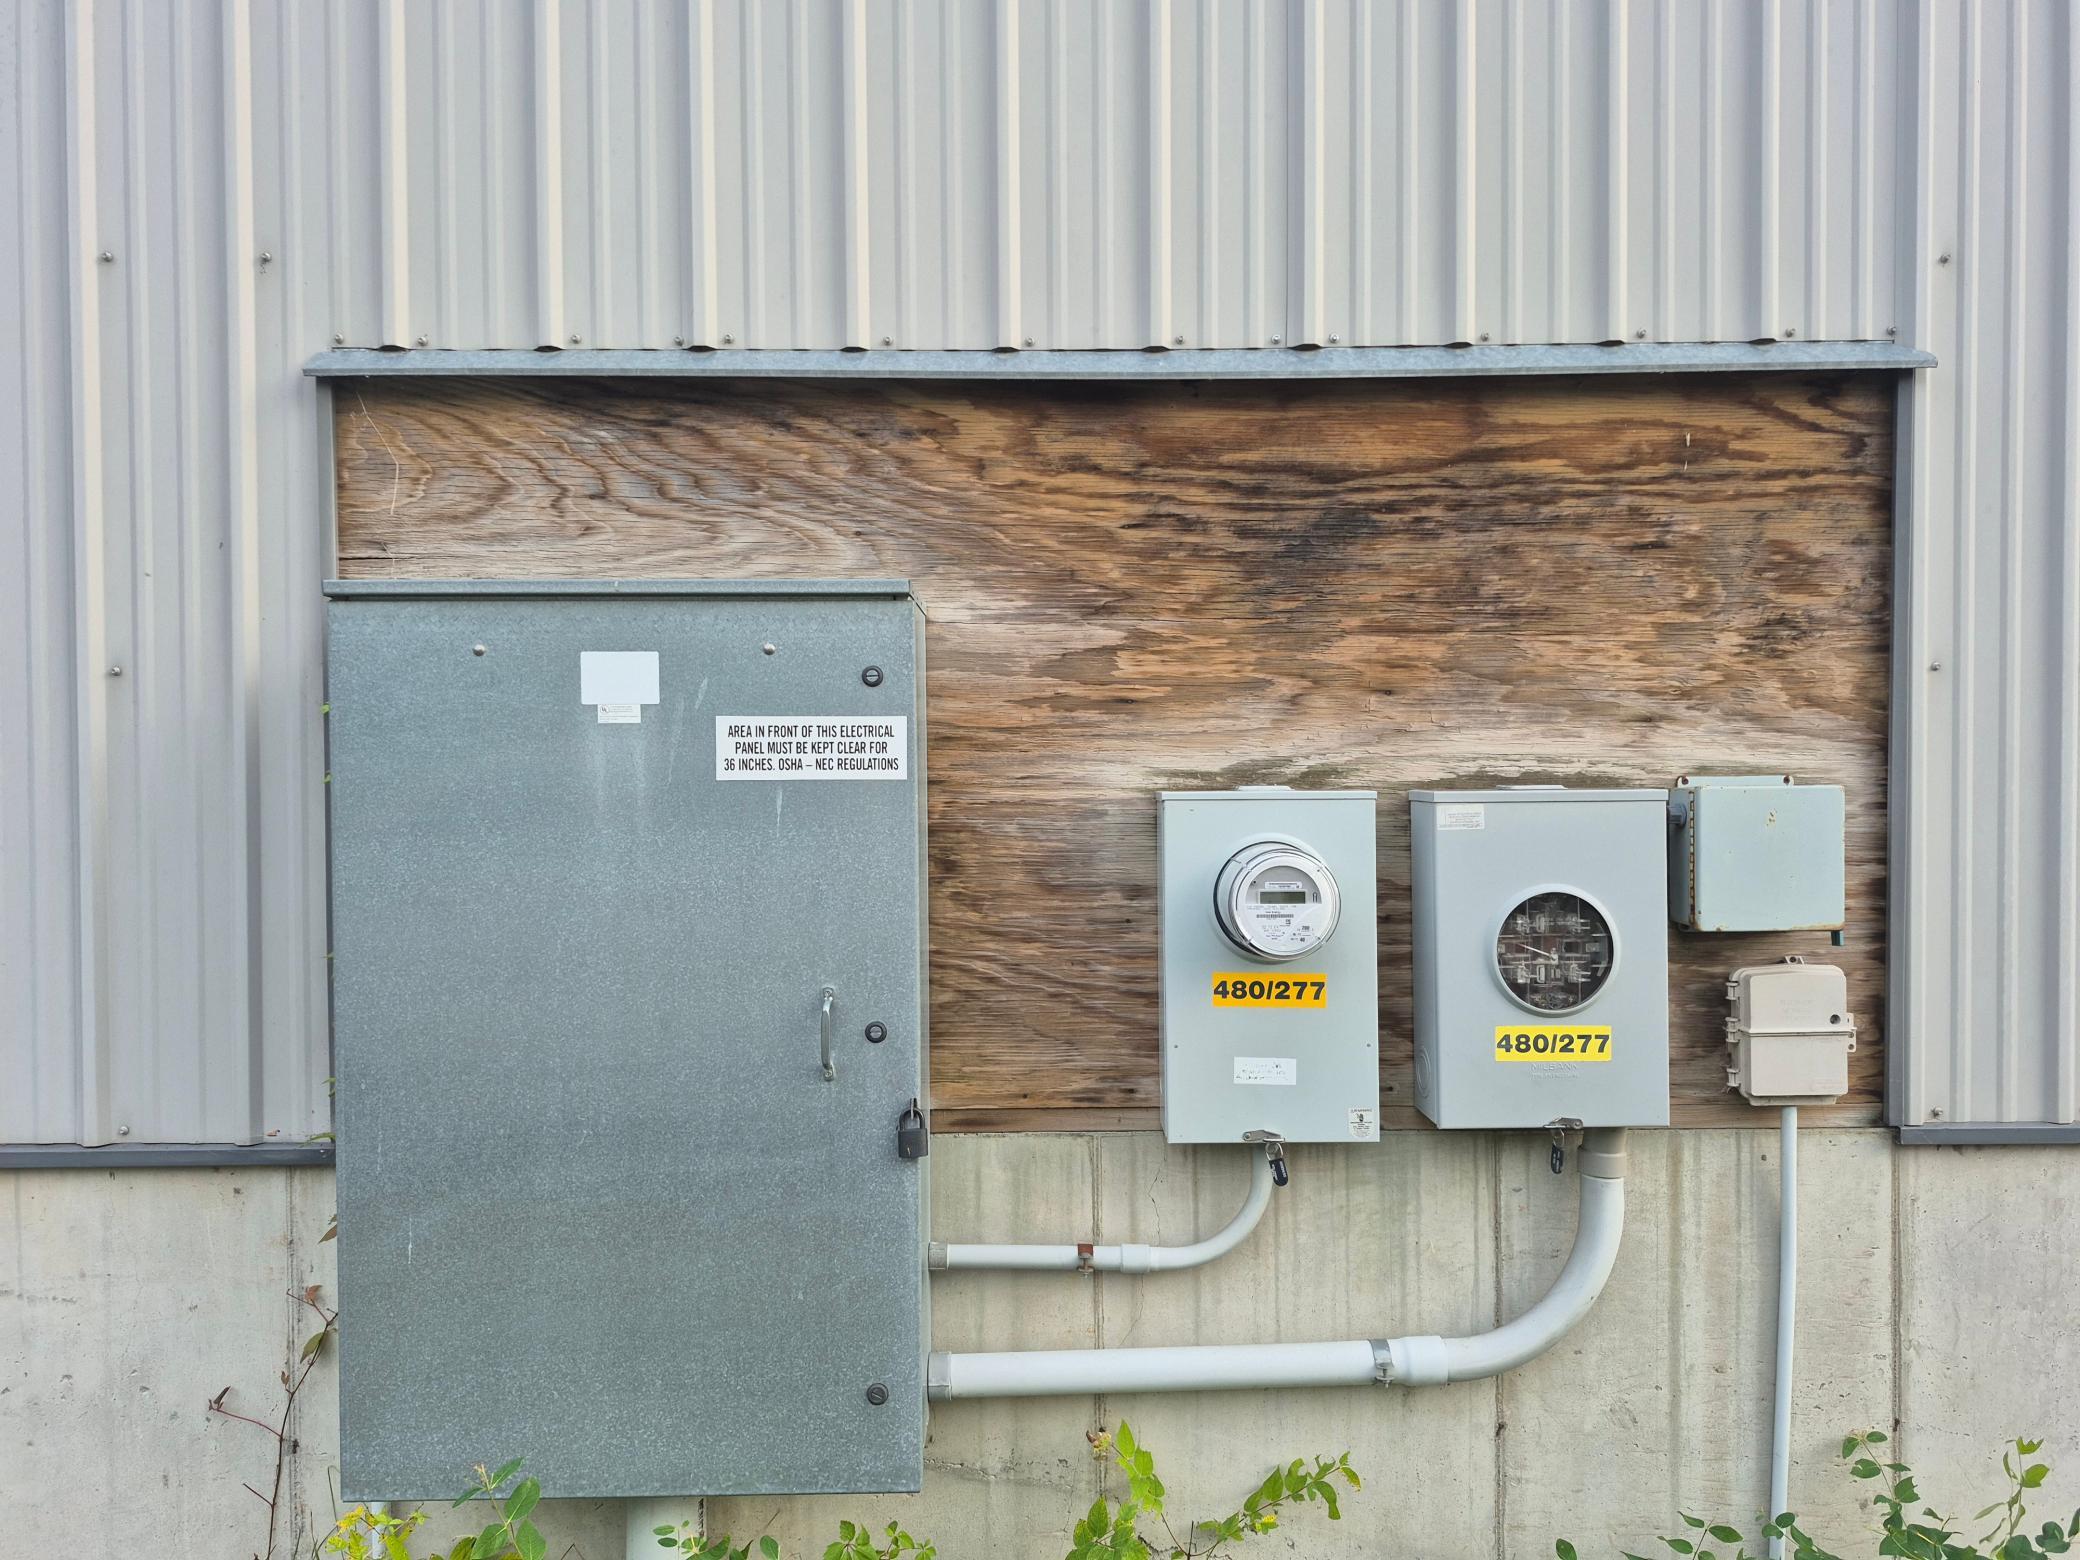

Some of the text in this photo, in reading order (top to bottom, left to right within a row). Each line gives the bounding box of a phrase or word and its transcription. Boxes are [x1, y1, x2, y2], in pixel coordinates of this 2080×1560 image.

[727, 725, 895, 738] AREA IN FRONT OF THIS ELECTRICAL
[735, 741, 888, 754] PANEL MUST BE KEPT CLEAR FOR
[724, 758, 736, 771] 36
[738, 758, 776, 771] INCHES.
[778, 758, 803, 771] OSHA
[815, 758, 834, 771] NEC
[837, 758, 899, 771] REGULATIONS
[1213, 980, 1326, 1001] 480/277
[1496, 1033, 1610, 1054] 480/277
